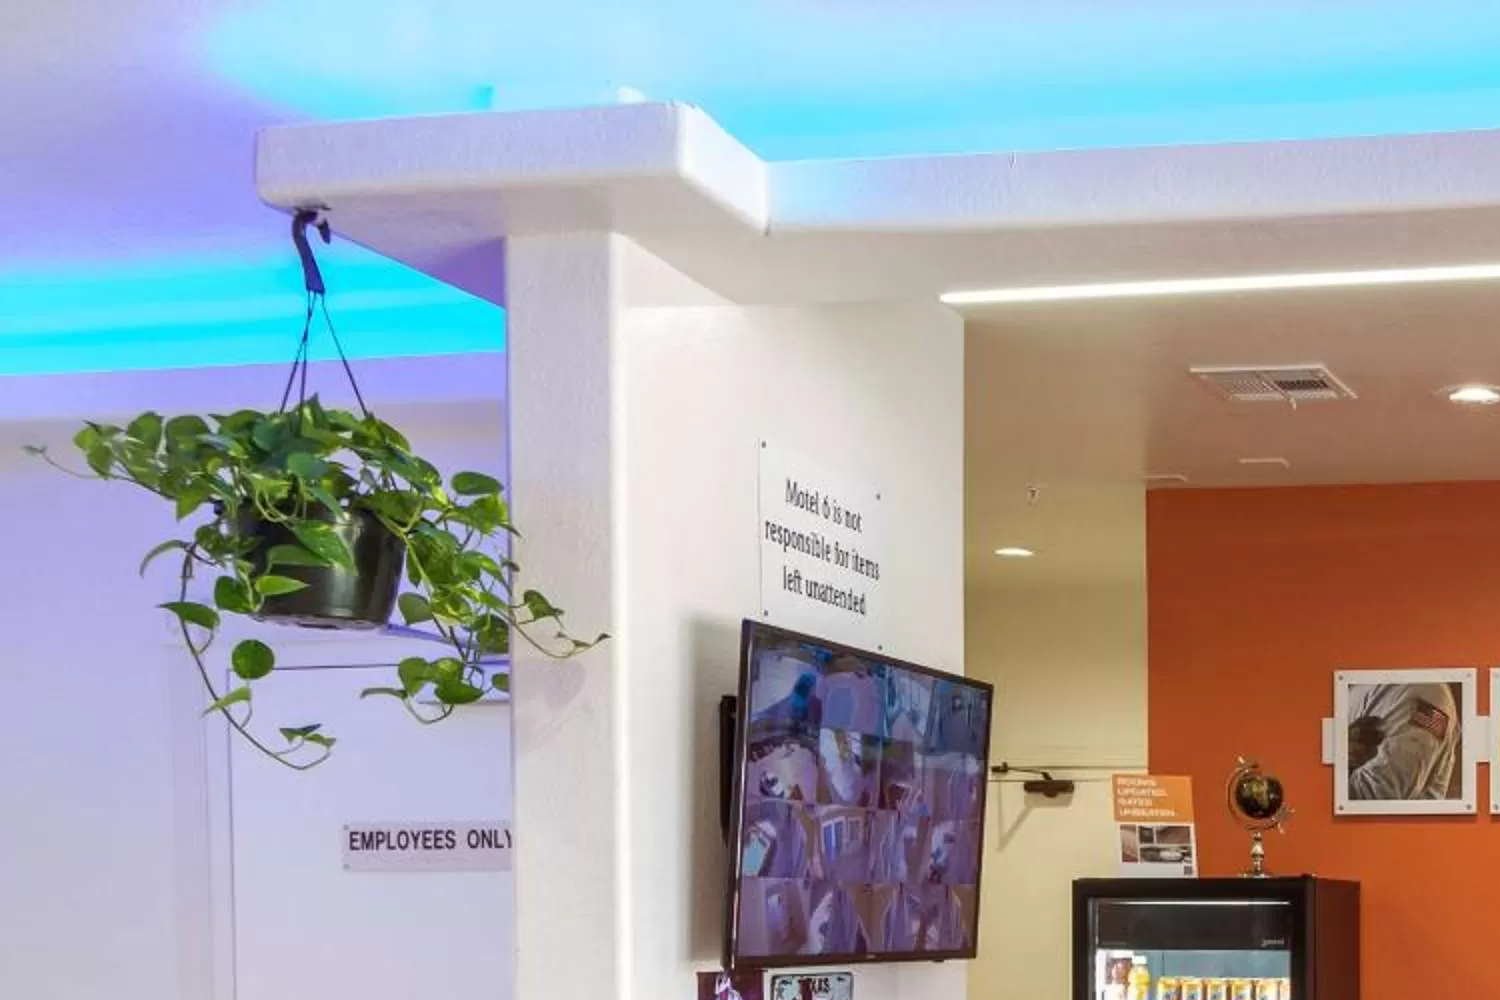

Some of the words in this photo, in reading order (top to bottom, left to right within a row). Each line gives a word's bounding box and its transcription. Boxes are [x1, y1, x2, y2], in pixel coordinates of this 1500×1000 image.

[785, 478, 819, 516] Motel
[822, 495, 831, 520] 6
[833, 500, 842, 525] is
[844, 509, 862, 533] not
[765, 520, 831, 563] responsible
[834, 541, 849, 568] for
[852, 549, 880, 581] items
[784, 566, 802, 594] left
[805, 579, 867, 615] unattended
[350, 829, 456, 851] EMPLOYEES
[467, 829, 512, 849] ONLY
